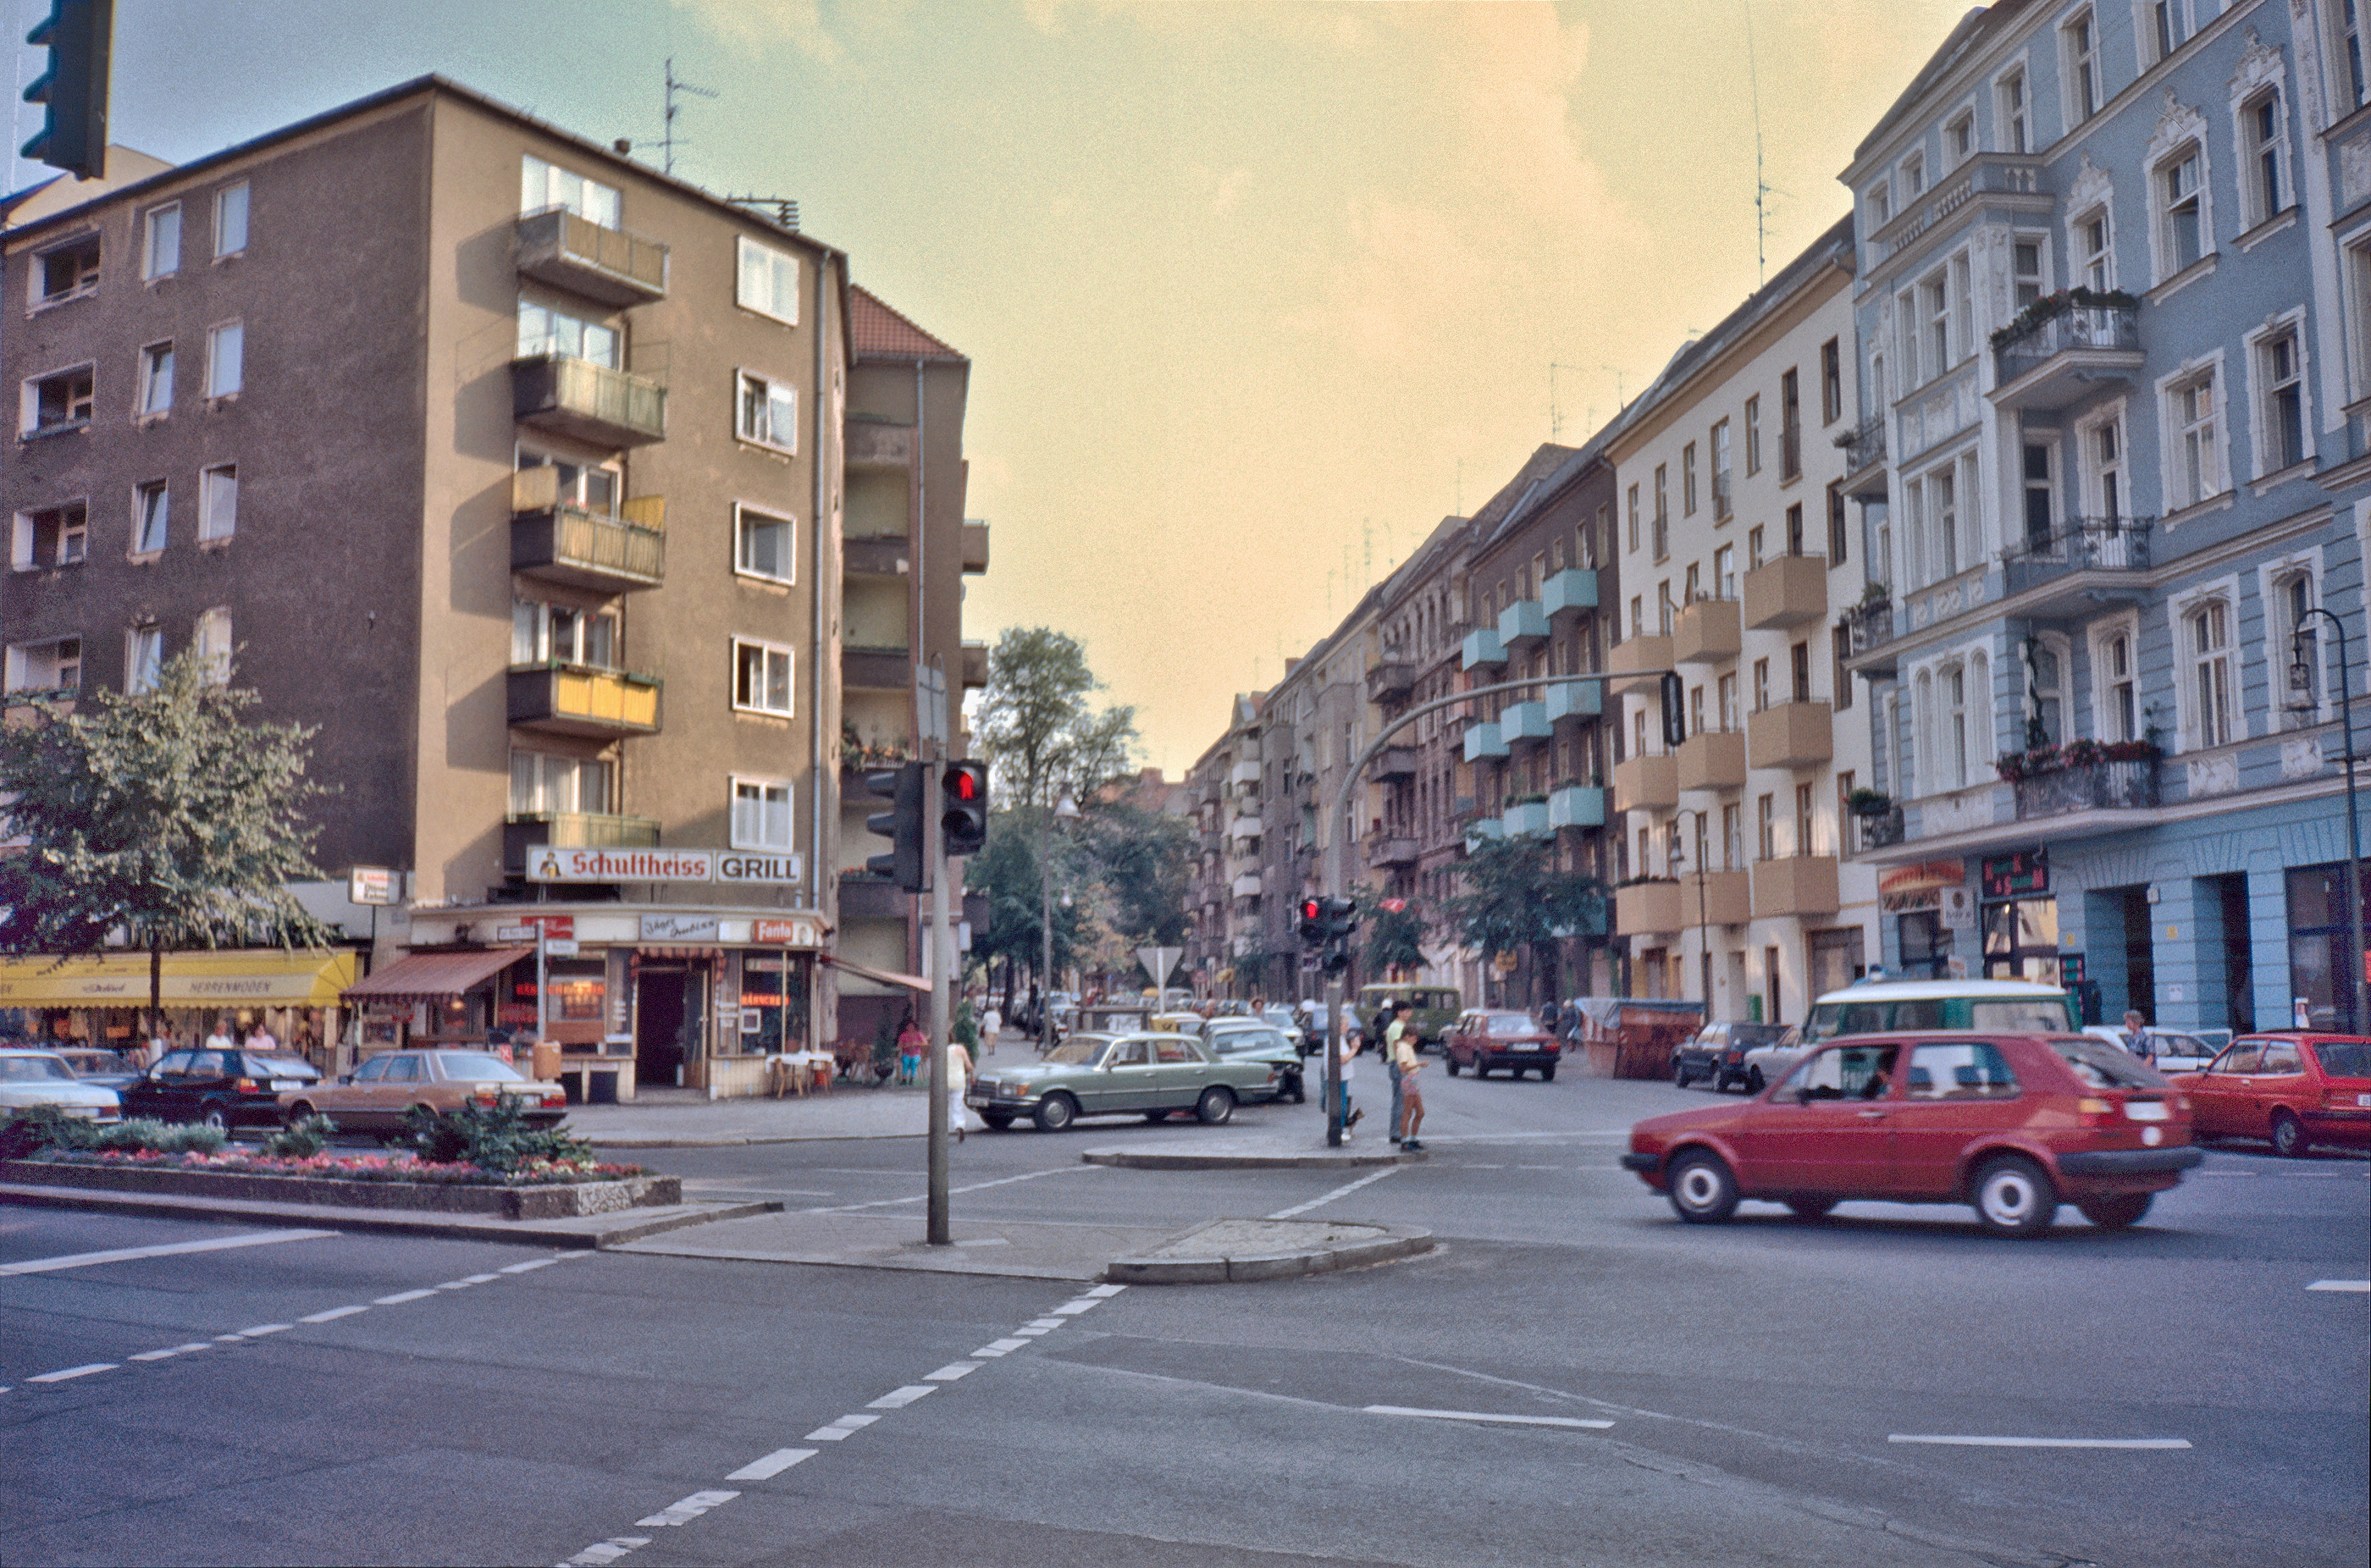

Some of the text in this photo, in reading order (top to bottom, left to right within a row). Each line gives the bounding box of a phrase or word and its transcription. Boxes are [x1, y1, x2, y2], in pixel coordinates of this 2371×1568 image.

[572, 852, 706, 877] Schultheiss
[721, 857, 797, 880] GRILL
[758, 921, 792, 941] Fanta
